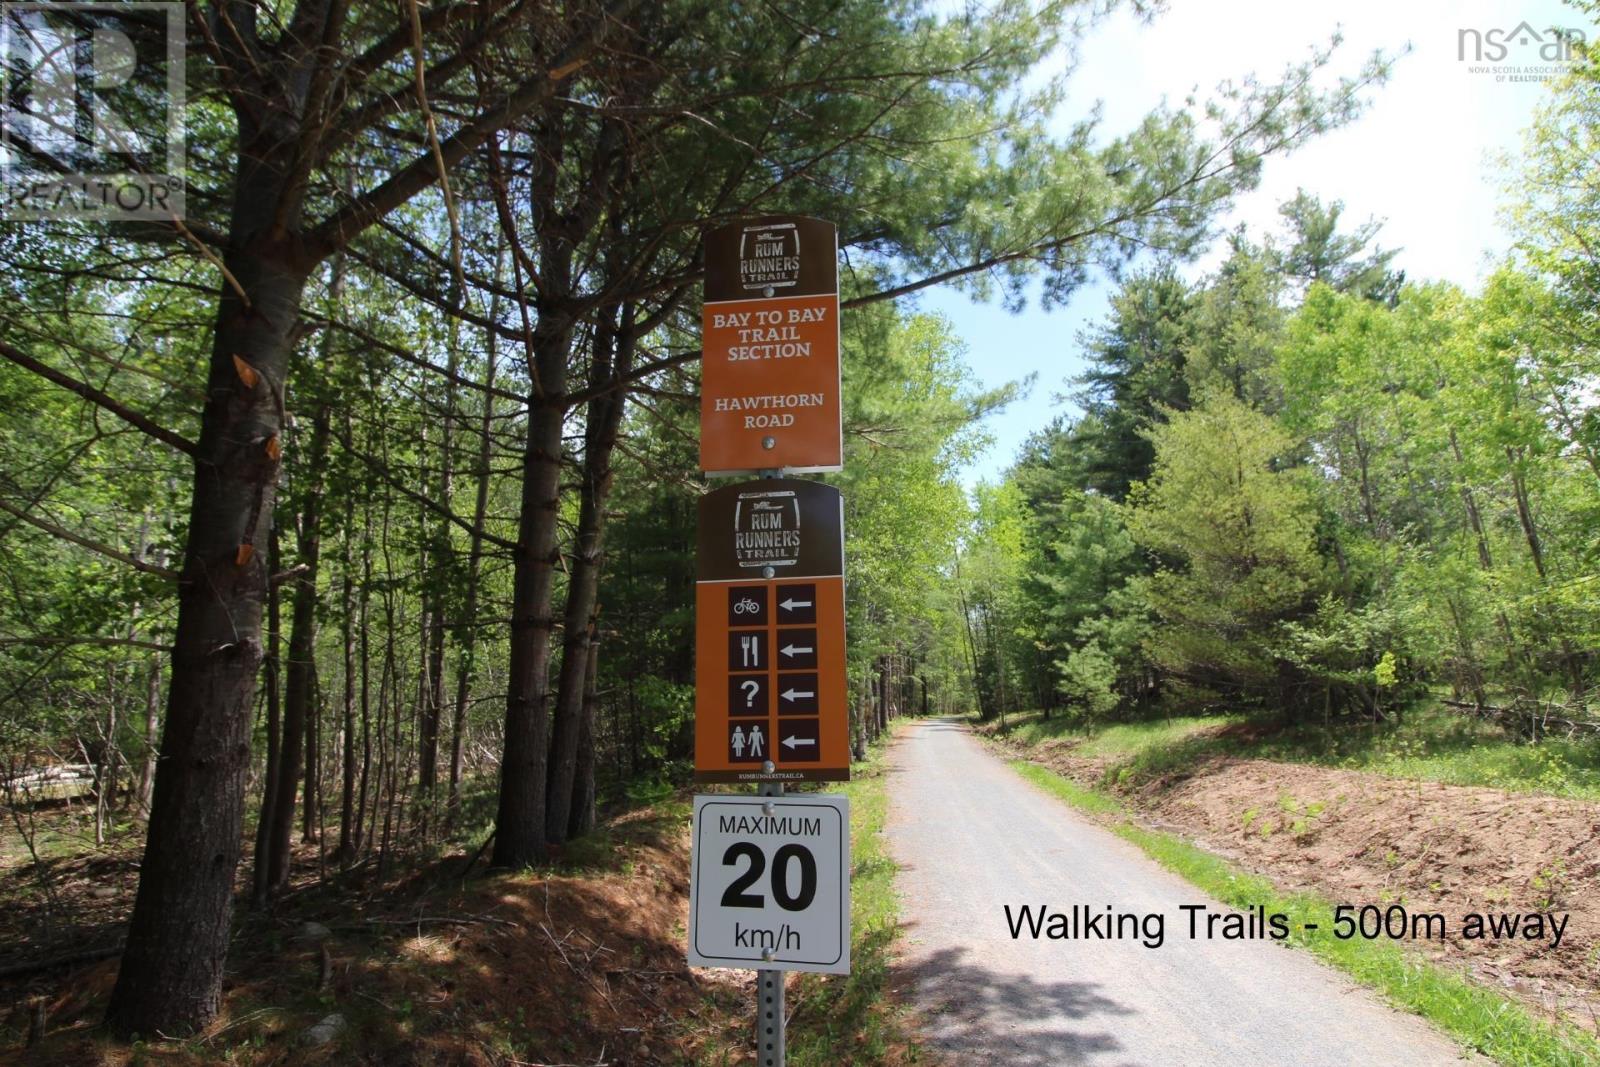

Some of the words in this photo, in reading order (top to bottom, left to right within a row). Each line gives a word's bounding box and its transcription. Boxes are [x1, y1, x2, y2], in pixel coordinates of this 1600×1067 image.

[755, 242, 783, 258] RUM
[740, 256, 800, 274] RUNNERS
[749, 271, 788, 282] TRAIL
[713, 312, 751, 328] BAY
[756, 310, 782, 325] TO
[788, 307, 827, 323] BAY
[739, 326, 800, 343] TRAIL
[727, 342, 811, 361] SECTION
[715, 393, 824, 411] HAWTHORN
[744, 413, 794, 429] ROAD
[751, 513, 782, 530] RUM
[736, 530, 800, 549] RUNNERS
[744, 548, 789, 559] TRAIL
[740, 680, 760, 708] ?
[719, 815, 821, 836] MAXIMUM
[720, 841, 817, 912] 20
[735, 922, 801, 952] km/h
